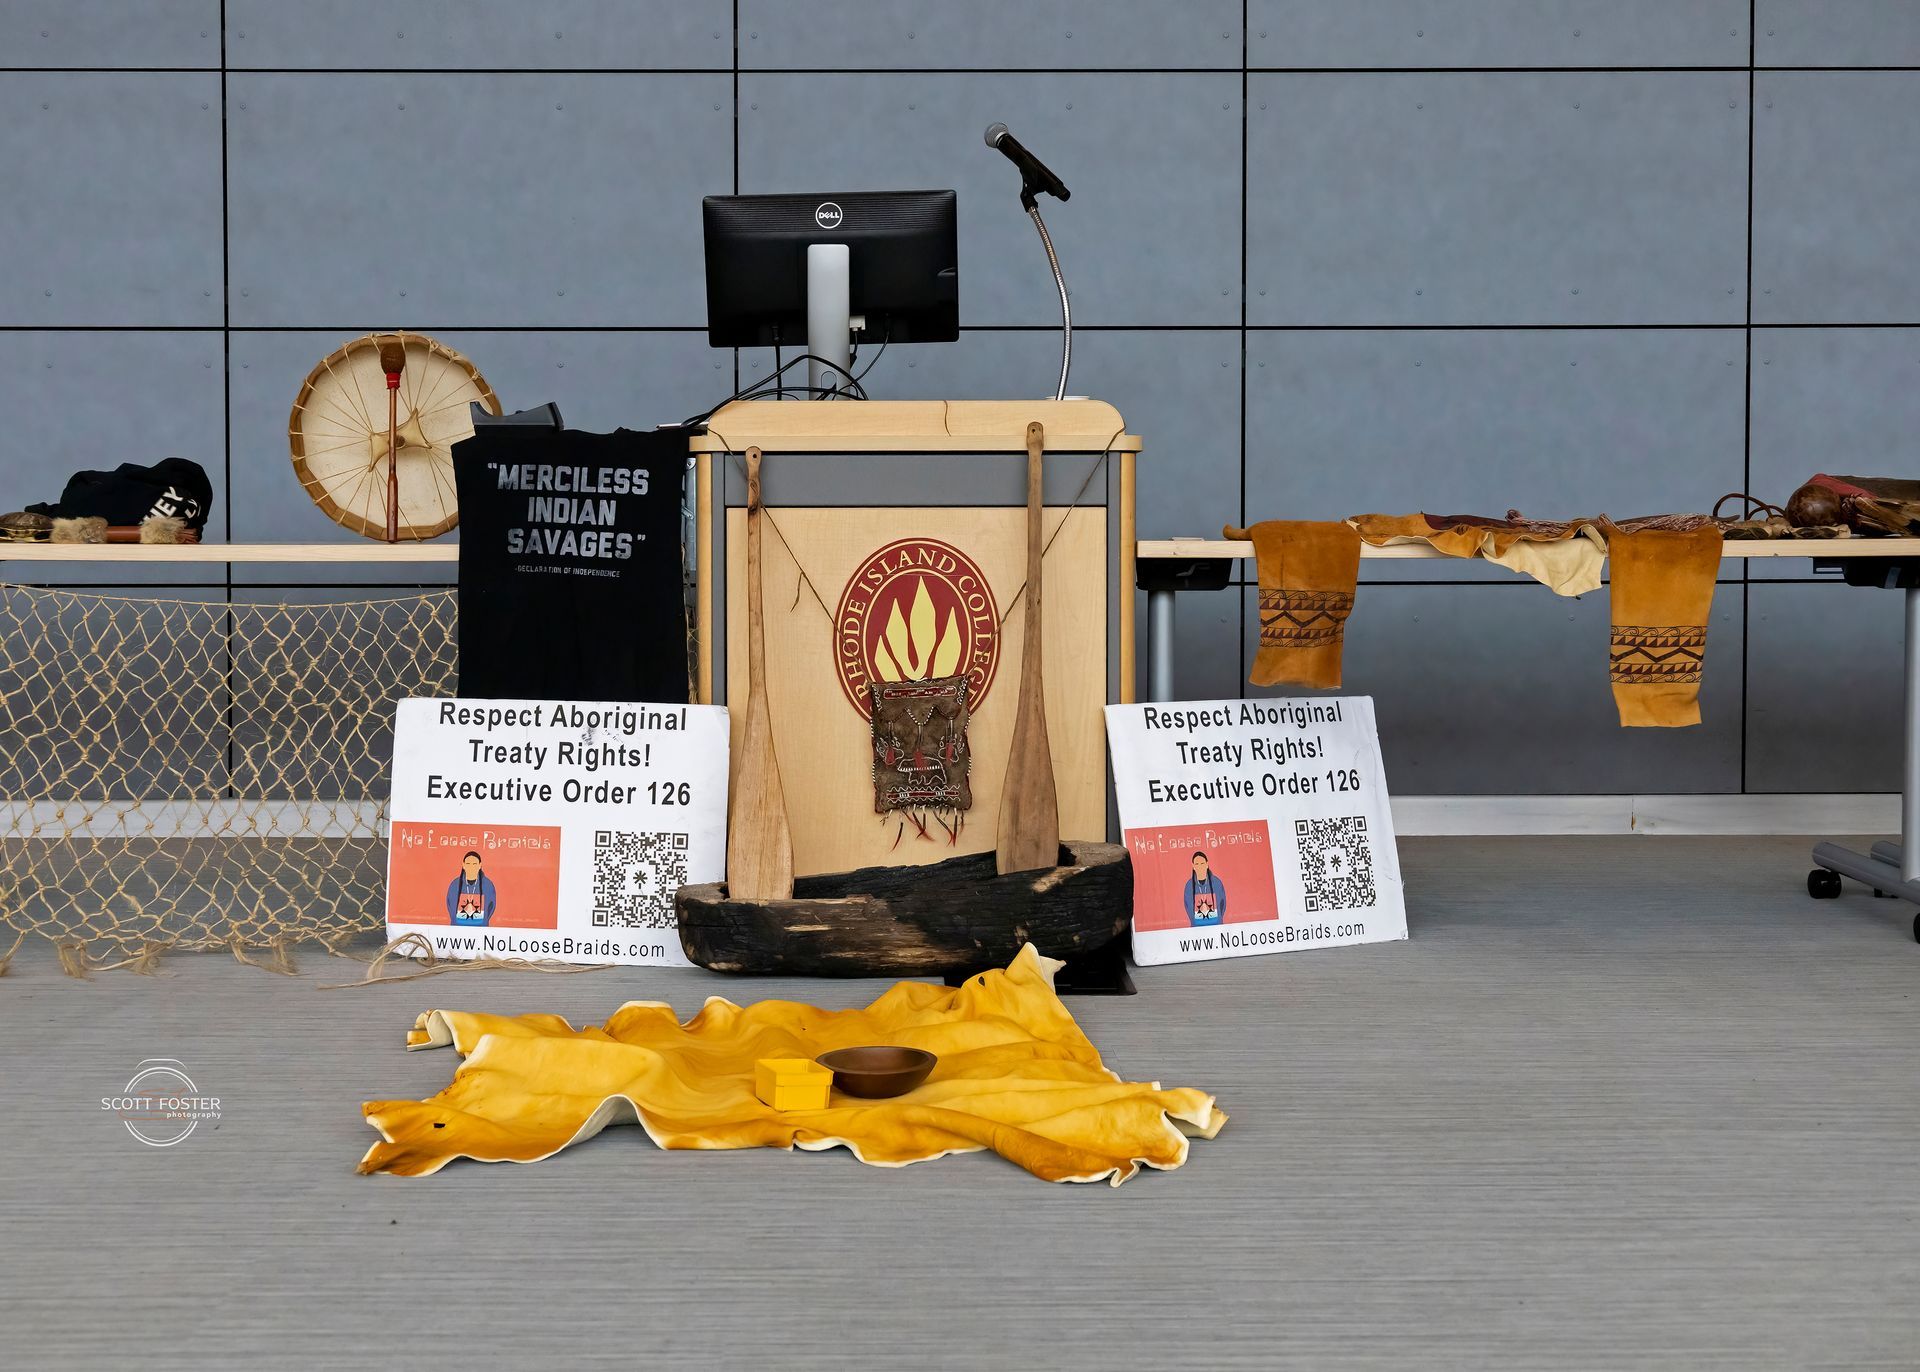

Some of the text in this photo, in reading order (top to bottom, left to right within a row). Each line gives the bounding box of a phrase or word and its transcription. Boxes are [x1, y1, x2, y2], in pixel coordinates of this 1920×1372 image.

[818, 211, 840, 219] DELL
[527, 496, 616, 526] INDIAN
[572, 568, 621, 577] INDEPENDENCE
[842, 599, 868, 700] RHODE
[858, 547, 957, 596] ISLAND
[439, 701, 687, 735] Respect Aboriginal
[1143, 701, 1342, 733] Respect Aboriginal
[469, 739, 651, 771] Treaty Rights!
[1176, 736, 1324, 768] Treaty Rights!
[427, 775, 691, 806] Executive Order 126
[1149, 769, 1361, 803] Executive Order 126
[401, 828, 551, 849] No Loose Braids
[1134, 835, 1155, 854] No
[1205, 830, 1262, 848] Braids
[436, 935, 665, 958] www.NoLooseBraids.com
[1179, 920, 1365, 952] www.NoLooseBraids.com
